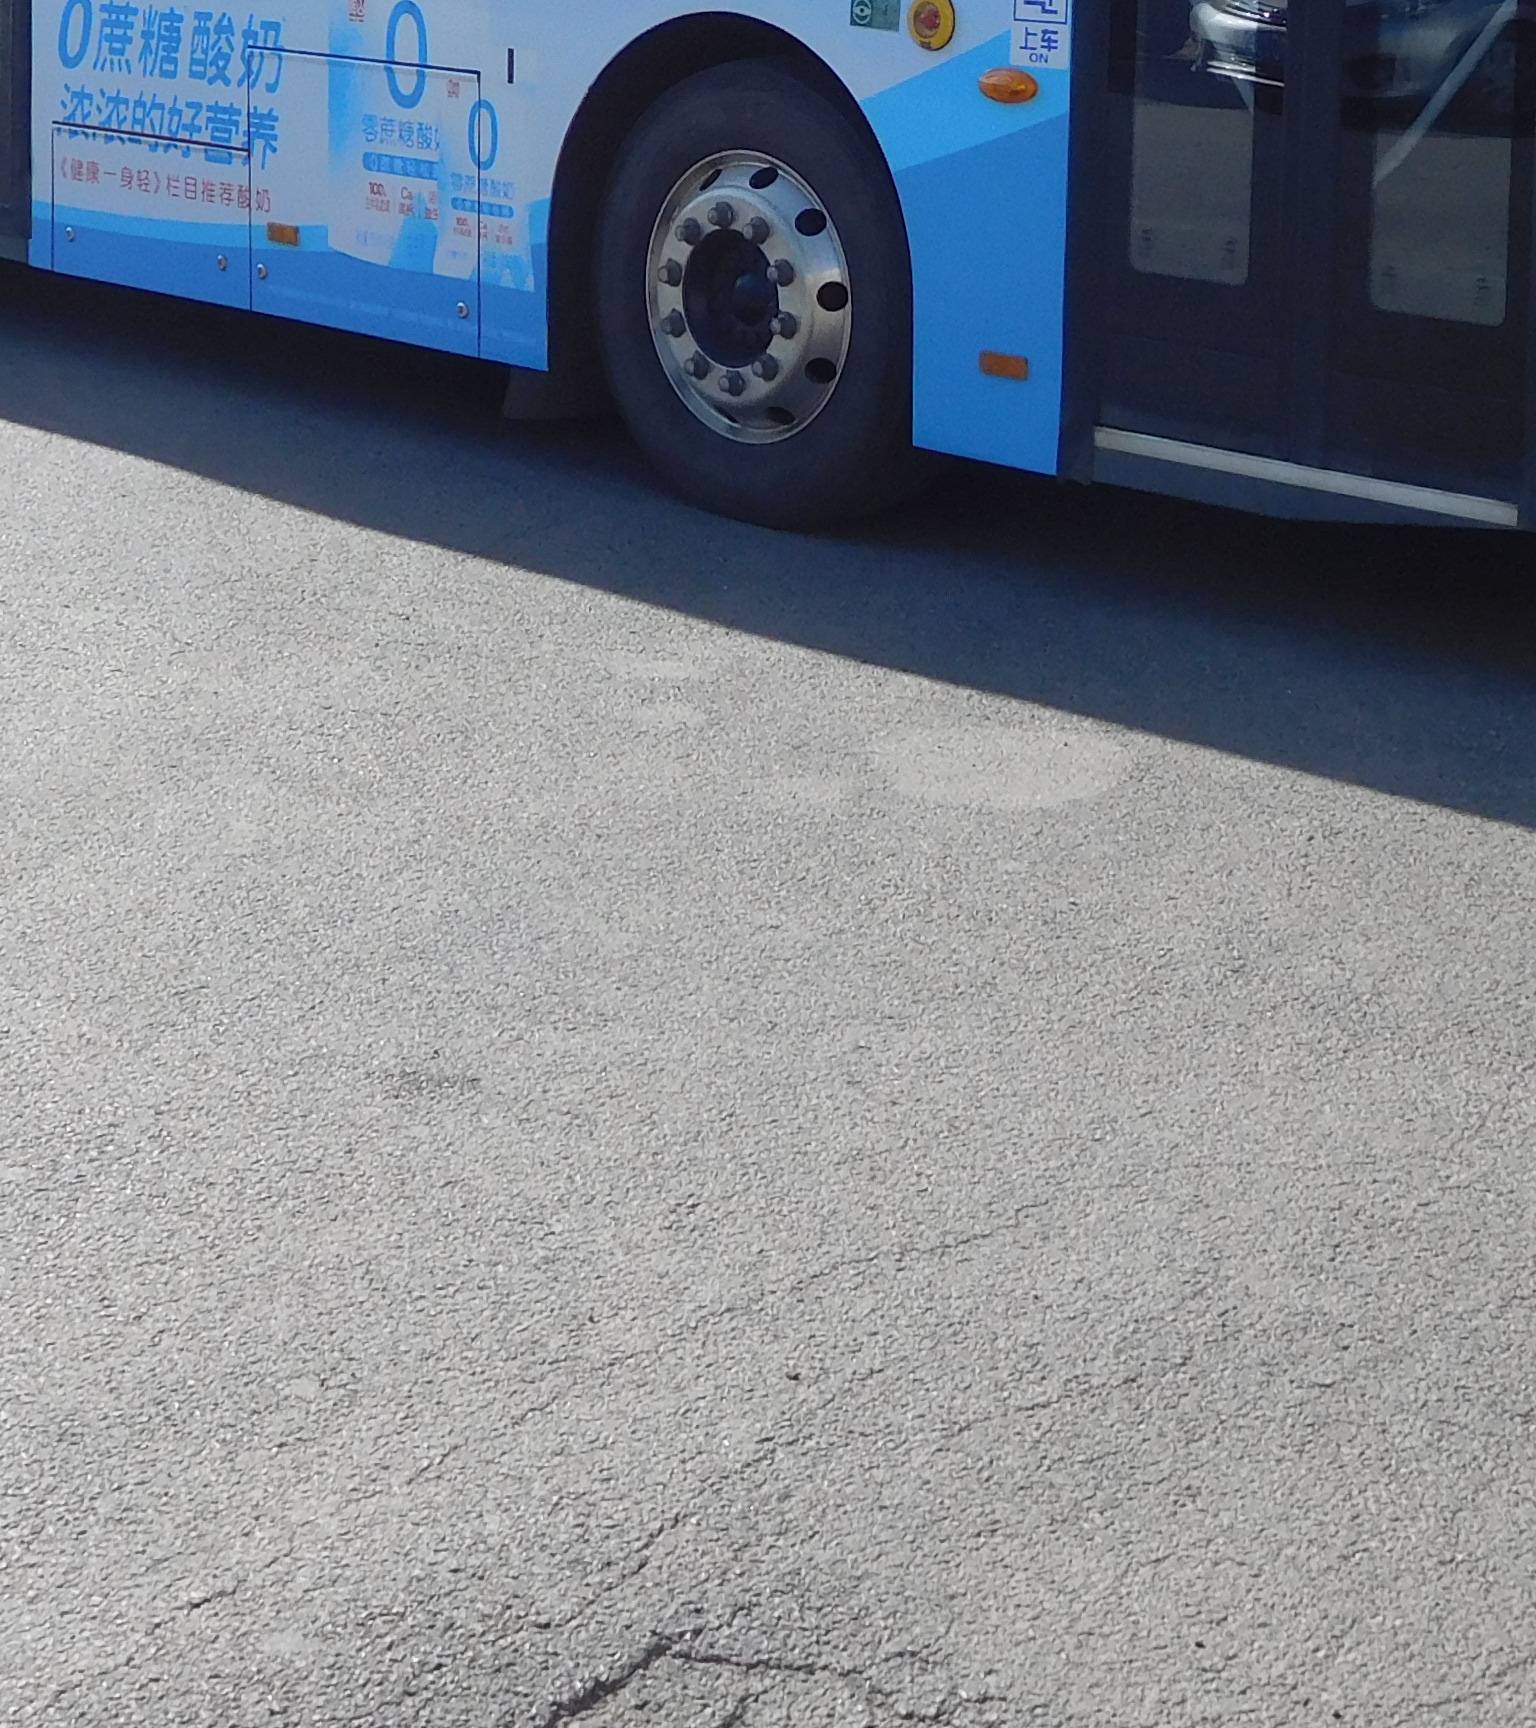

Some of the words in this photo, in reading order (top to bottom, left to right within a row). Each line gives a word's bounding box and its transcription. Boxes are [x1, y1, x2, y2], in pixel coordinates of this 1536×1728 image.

[1019, 27, 1059, 52] 上车
[1029, 53, 1049, 64] ON
[56, 83, 279, 170] 浓浓的好营养
[60, 158, 272, 213] 《健康一身轻》栏目推荐酸奶
